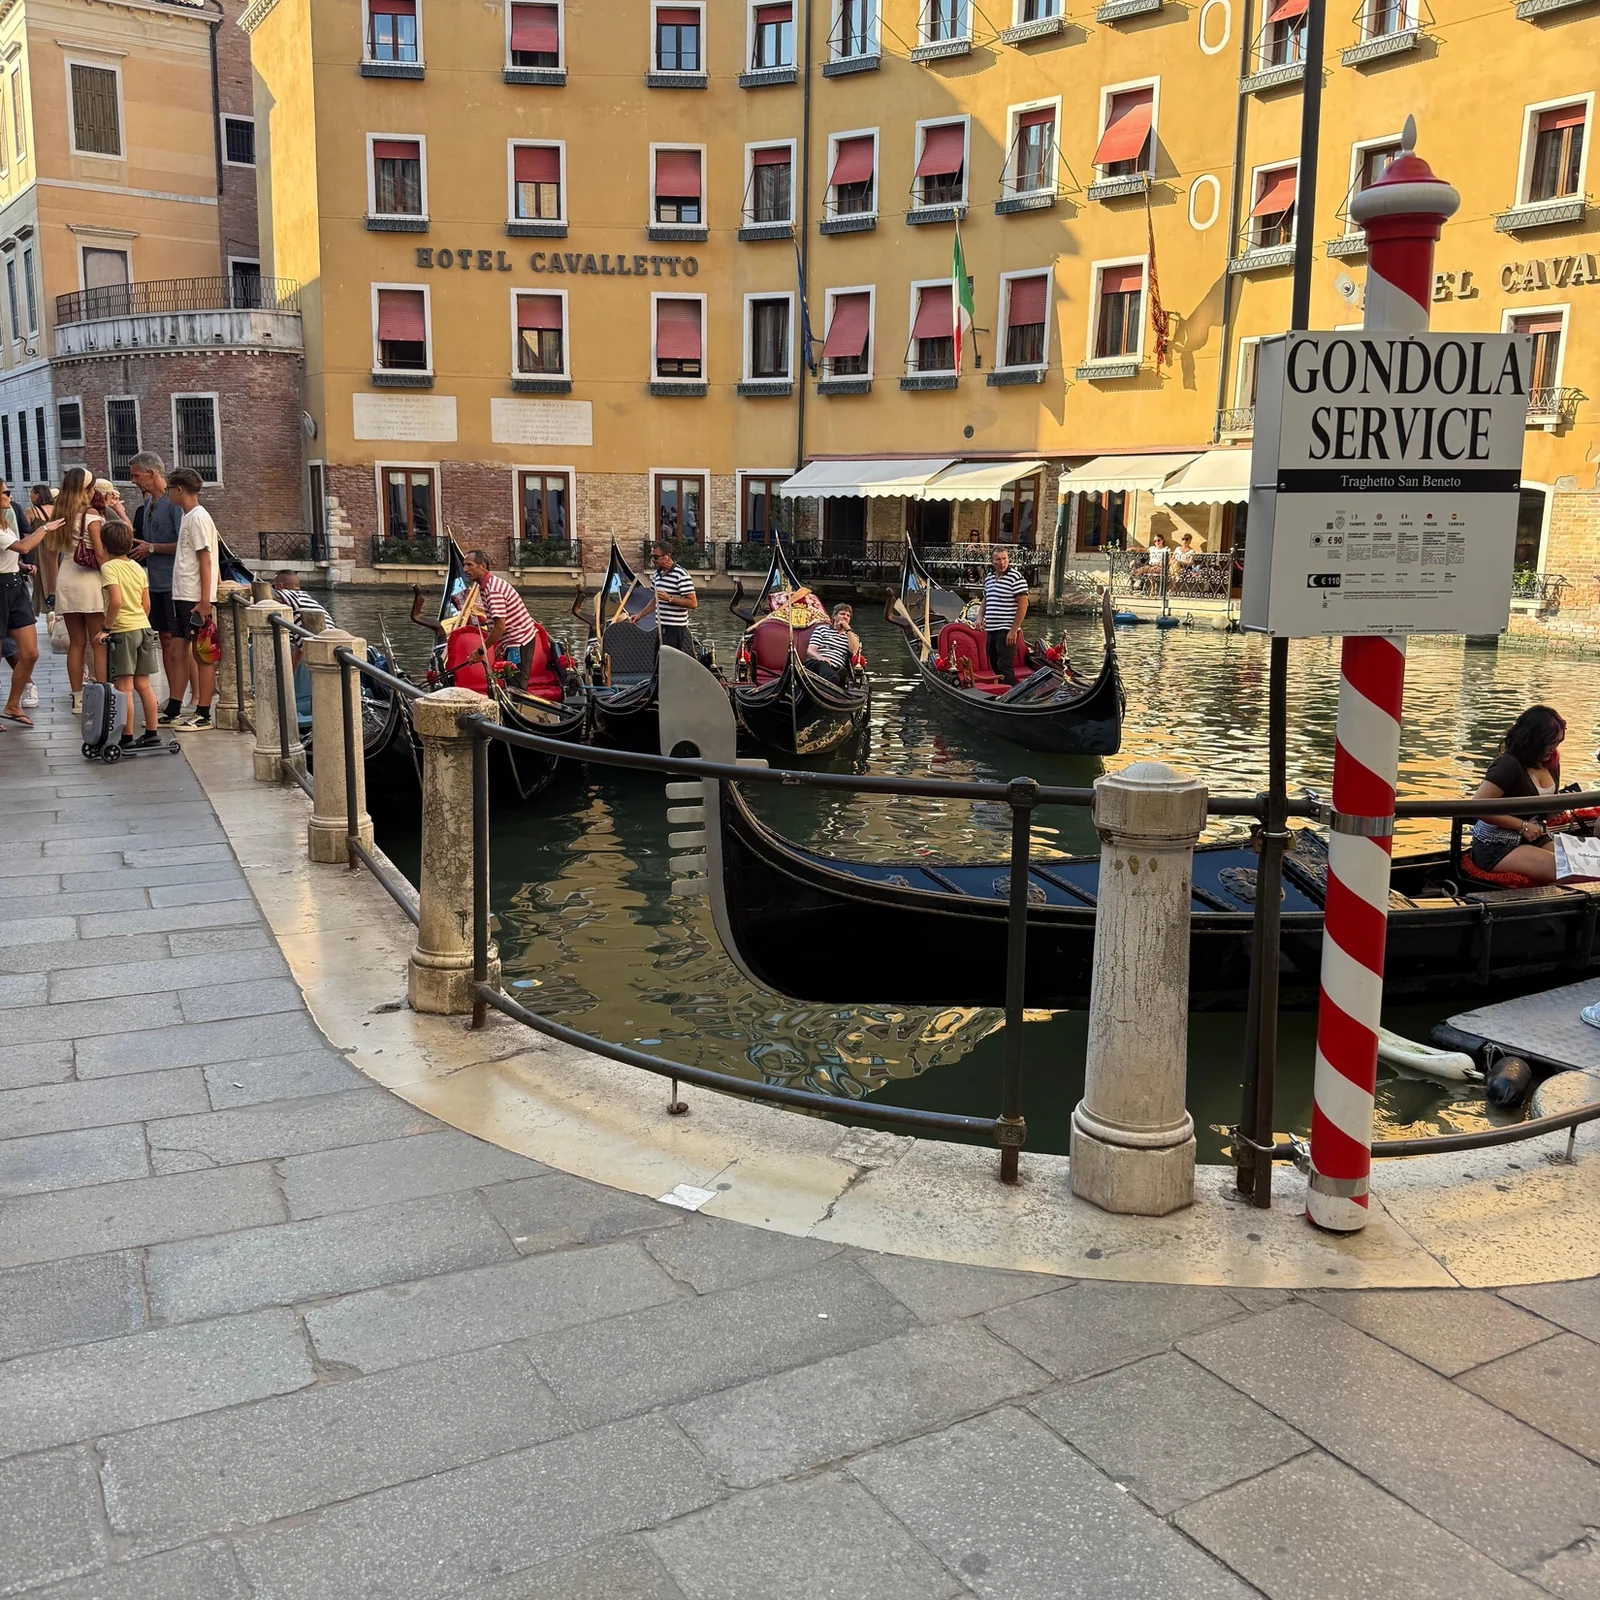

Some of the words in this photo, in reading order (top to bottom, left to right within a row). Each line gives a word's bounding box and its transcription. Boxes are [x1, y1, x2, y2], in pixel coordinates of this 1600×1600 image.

[416, 247, 512, 271] HOTEL
[530, 252, 699, 277] CAVALLETTO
[1500, 252, 1600, 292] CAVA
[1287, 339, 1526, 395] GONDOLA
[1308, 406, 1492, 460] SERVICE
[1340, 475, 1395, 490] Traghetto
[1397, 475, 1419, 487] San
[1422, 475, 1462, 487] Beneto
[1327, 576, 1340, 585] 110
